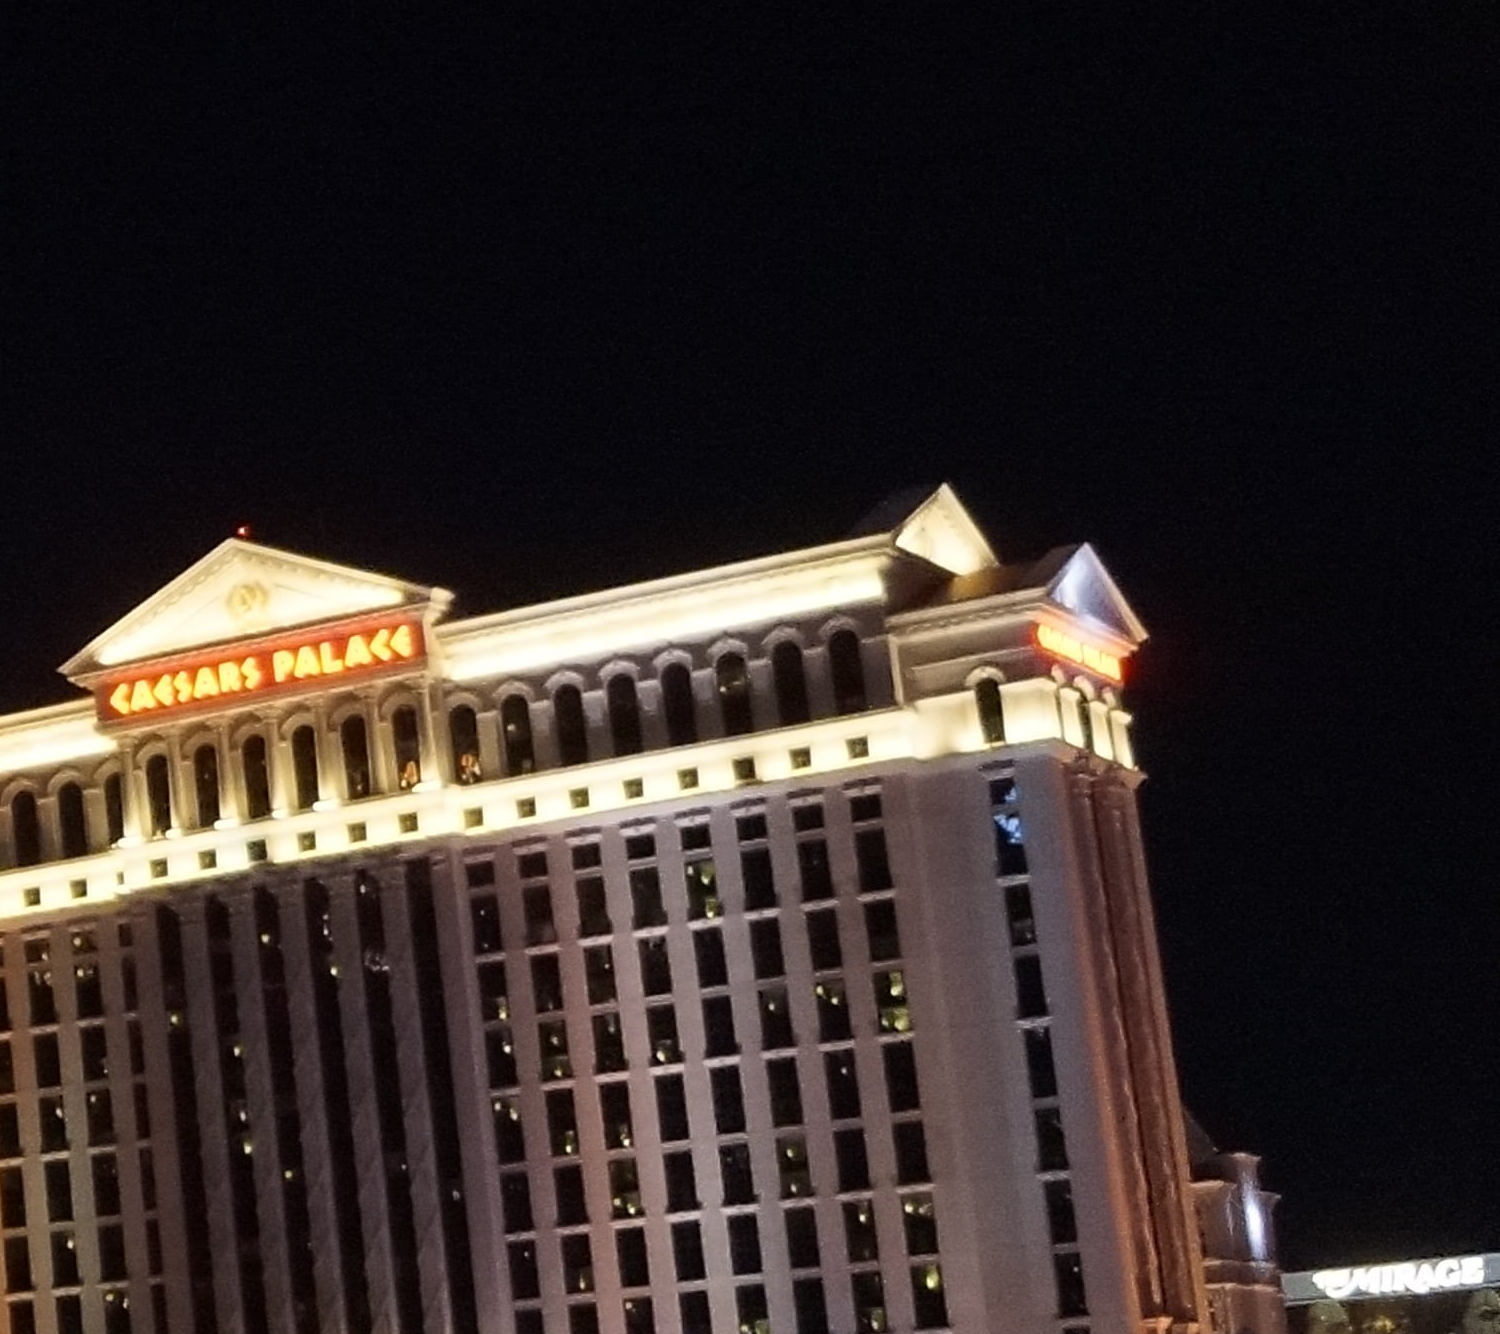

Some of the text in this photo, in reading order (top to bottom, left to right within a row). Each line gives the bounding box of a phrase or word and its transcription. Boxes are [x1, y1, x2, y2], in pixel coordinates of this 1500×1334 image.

[110, 625, 412, 715] CAESARS PALACE
[1353, 1257, 1484, 1294] MIRAGE
